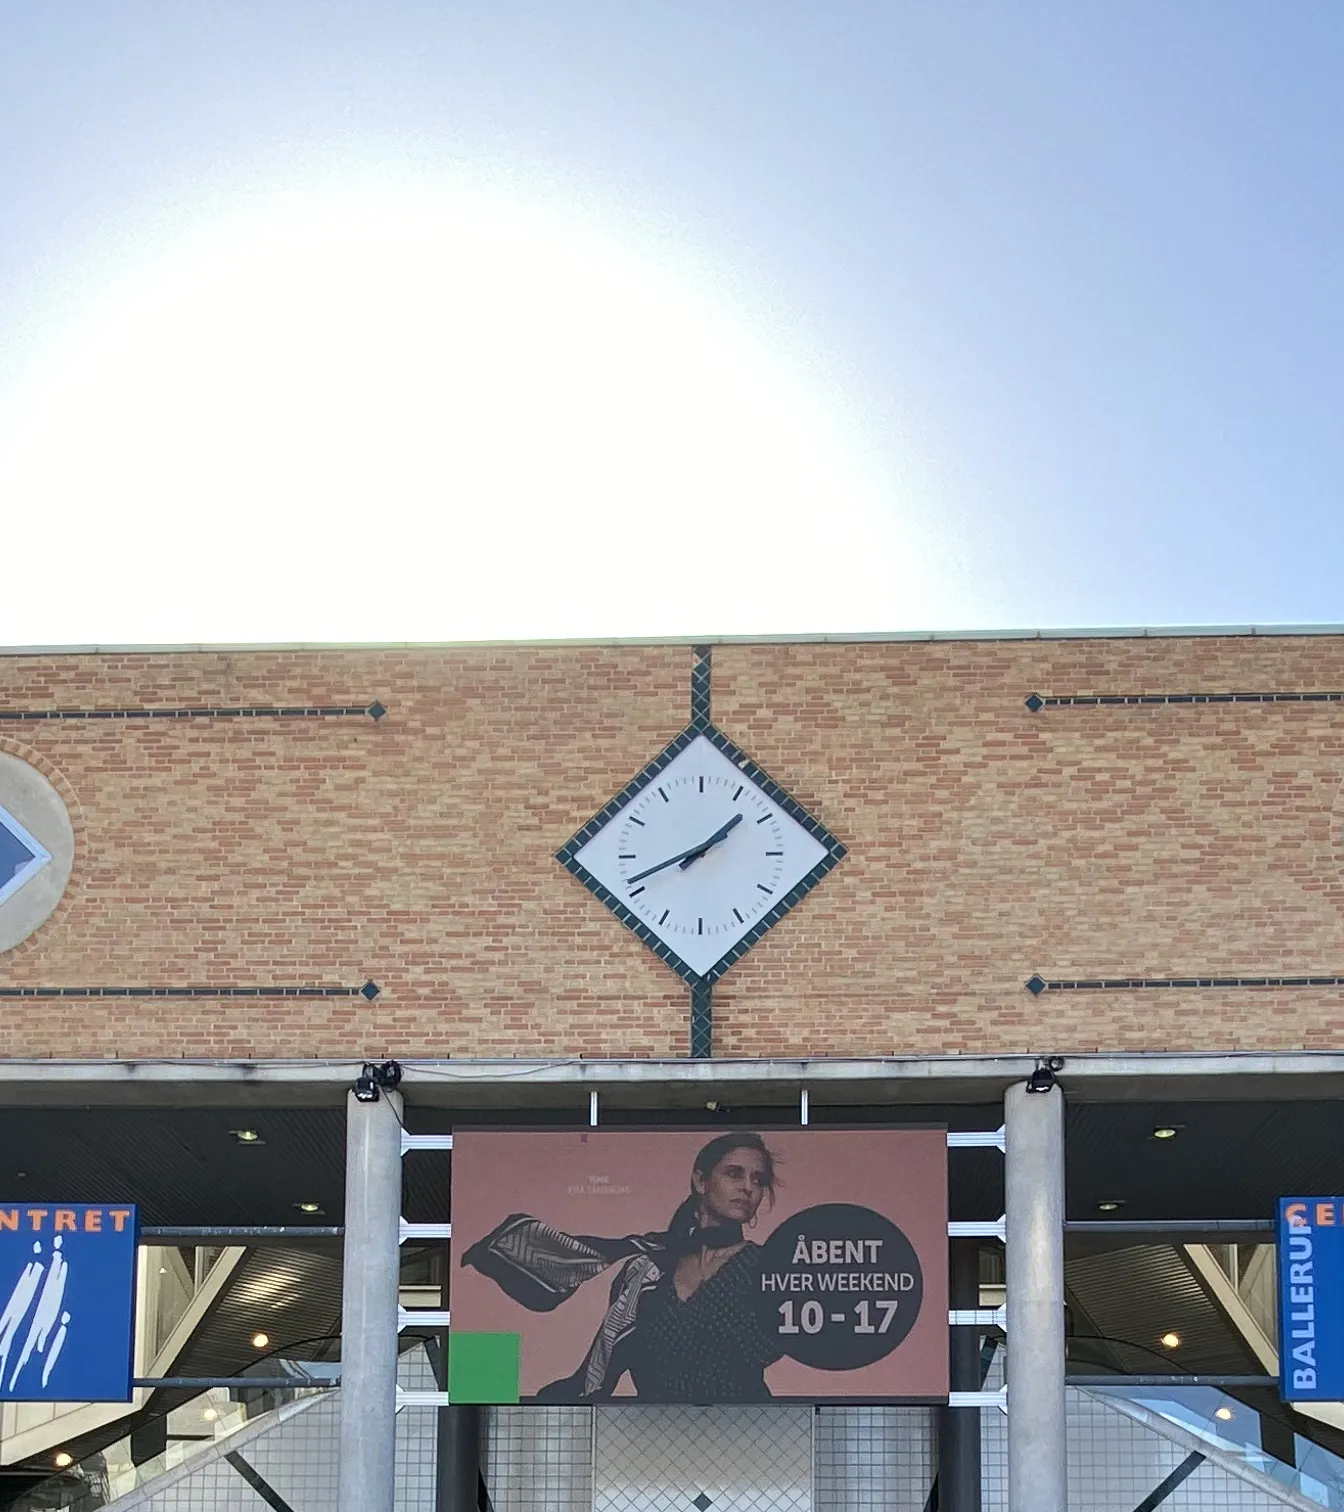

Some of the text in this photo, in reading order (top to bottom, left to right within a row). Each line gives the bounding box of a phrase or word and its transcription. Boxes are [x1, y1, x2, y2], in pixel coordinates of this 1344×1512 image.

[792, 1234, 884, 1265] ÅBENT
[761, 1273, 915, 1292] HVER WEEKEND
[778, 1300, 824, 1334] 10
[854, 1300, 898, 1334] 17
[1288, 1215, 1317, 1390] BALLERUP
